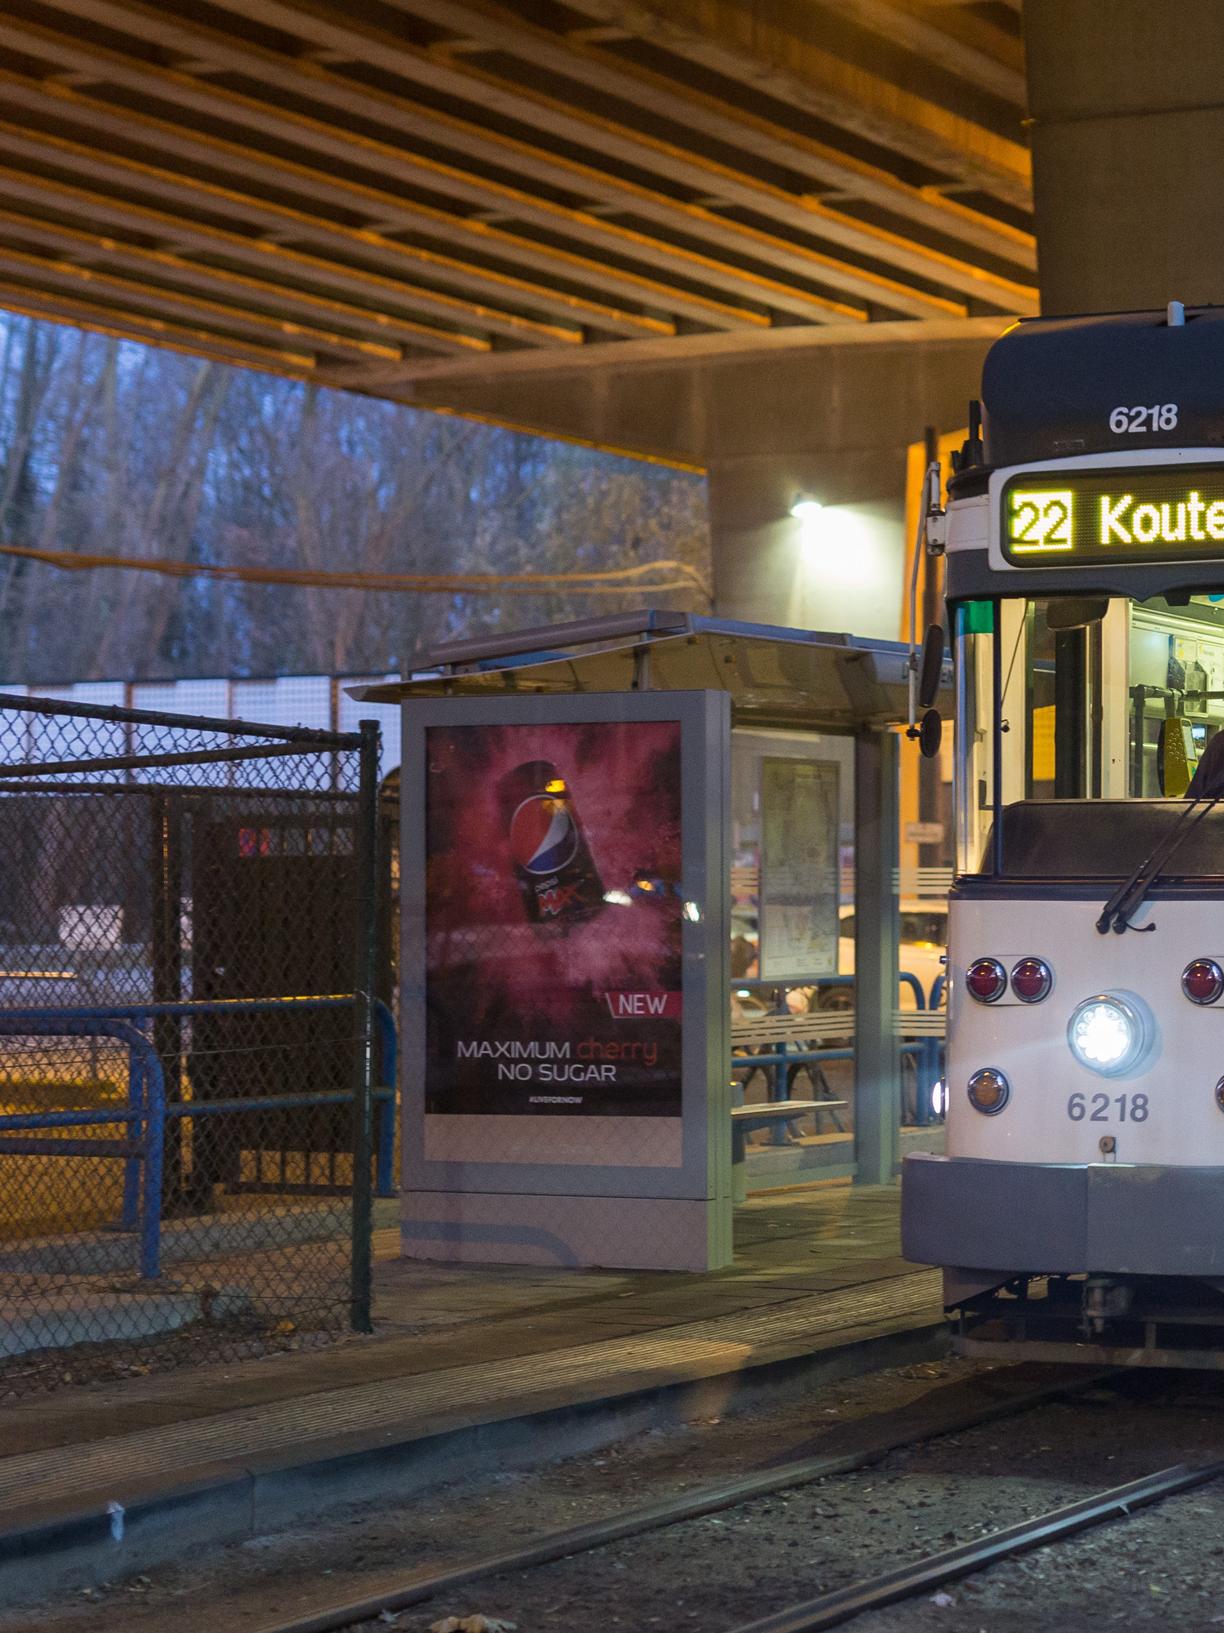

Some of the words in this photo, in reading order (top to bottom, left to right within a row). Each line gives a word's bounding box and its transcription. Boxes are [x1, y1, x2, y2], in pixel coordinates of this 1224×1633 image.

[1109, 403, 1178, 434] 6218
[1011, 494, 1071, 549] 22
[618, 994, 668, 1014] NEW
[457, 1041, 571, 1059] MAXIMUM
[576, 1037, 657, 1066] cherry
[498, 1063, 533, 1081] NO
[538, 1063, 617, 1082] SUGAR
[1067, 1092, 1149, 1122] 6218
